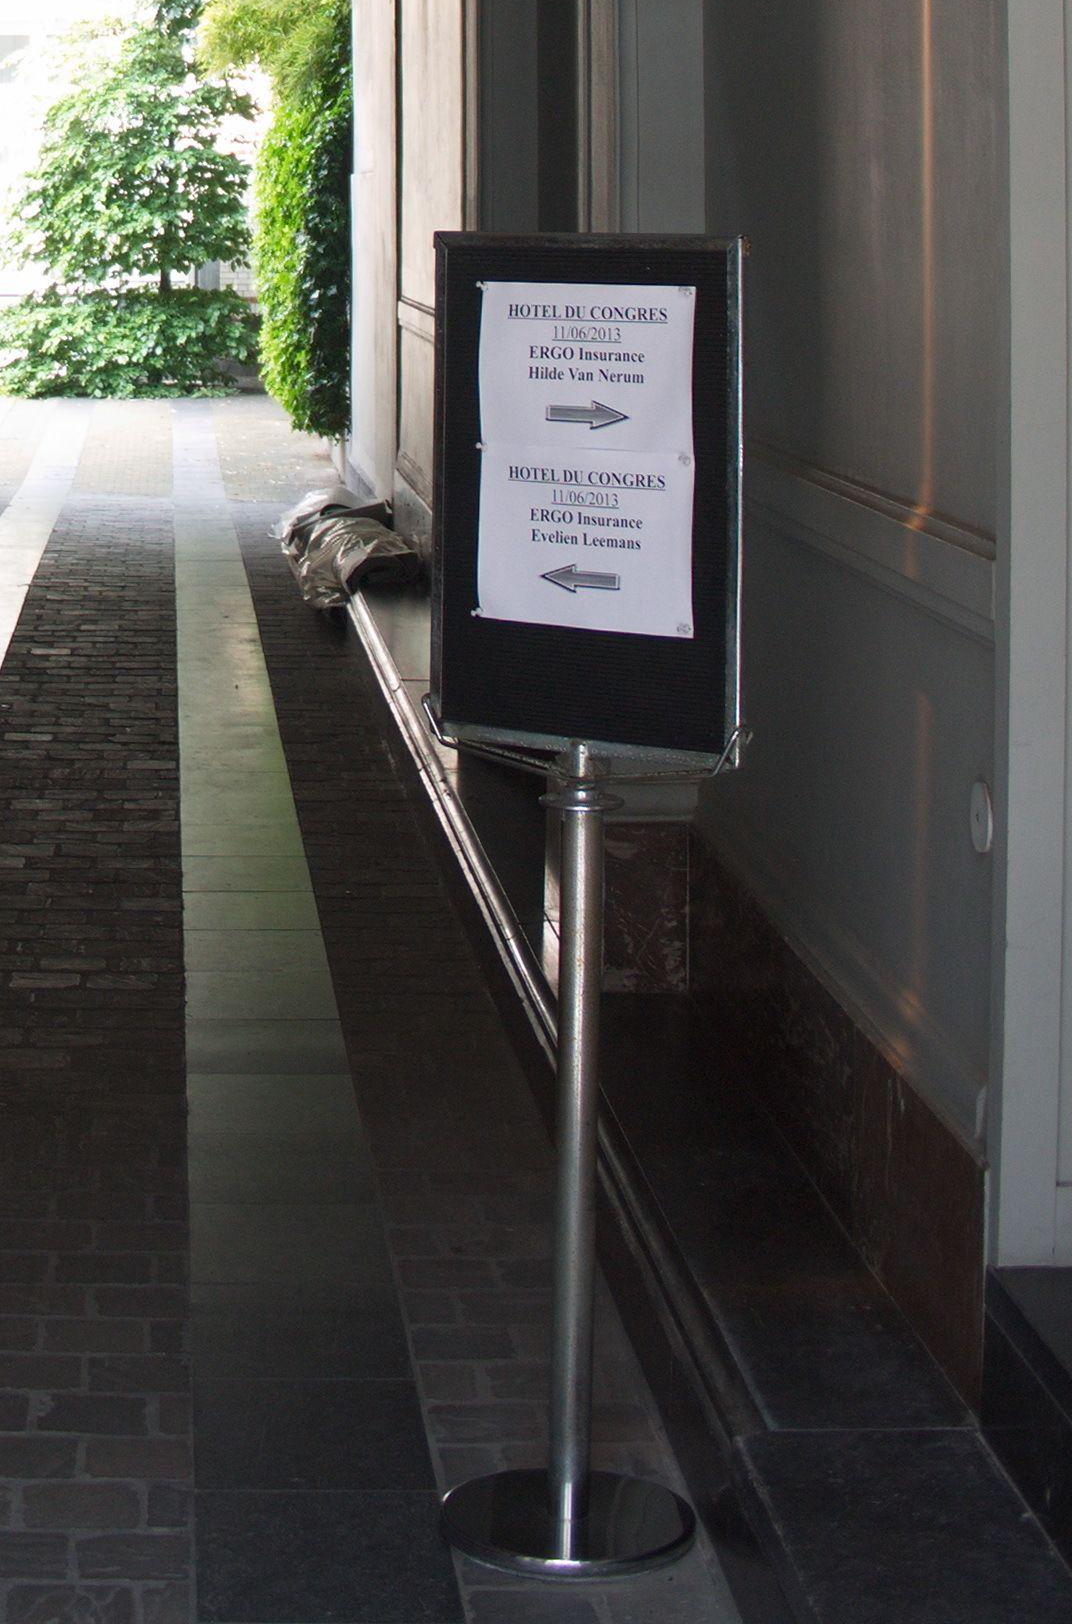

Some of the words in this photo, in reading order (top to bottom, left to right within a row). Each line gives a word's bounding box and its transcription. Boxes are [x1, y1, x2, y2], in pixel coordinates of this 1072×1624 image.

[509, 304, 561, 319] HOTEL
[565, 306, 586, 319] DU
[590, 307, 668, 322] CONGRES
[553, 326, 621, 341] 11/06/2013
[529, 346, 574, 361] ERGO
[579, 348, 645, 363] Insurance
[528, 367, 565, 381] Hilde
[568, 368, 594, 382] Van
[598, 370, 644, 384] Nerum
[509, 466, 560, 482] HOTEL
[563, 470, 583, 483] DU
[587, 471, 666, 489] CONGRES
[552, 489, 619, 507] 11/06/2013
[530, 508, 573, 525] ERGO
[578, 512, 643, 529] Insurance
[531, 529, 578, 546] Evelien
[583, 533, 641, 550] Leemans
